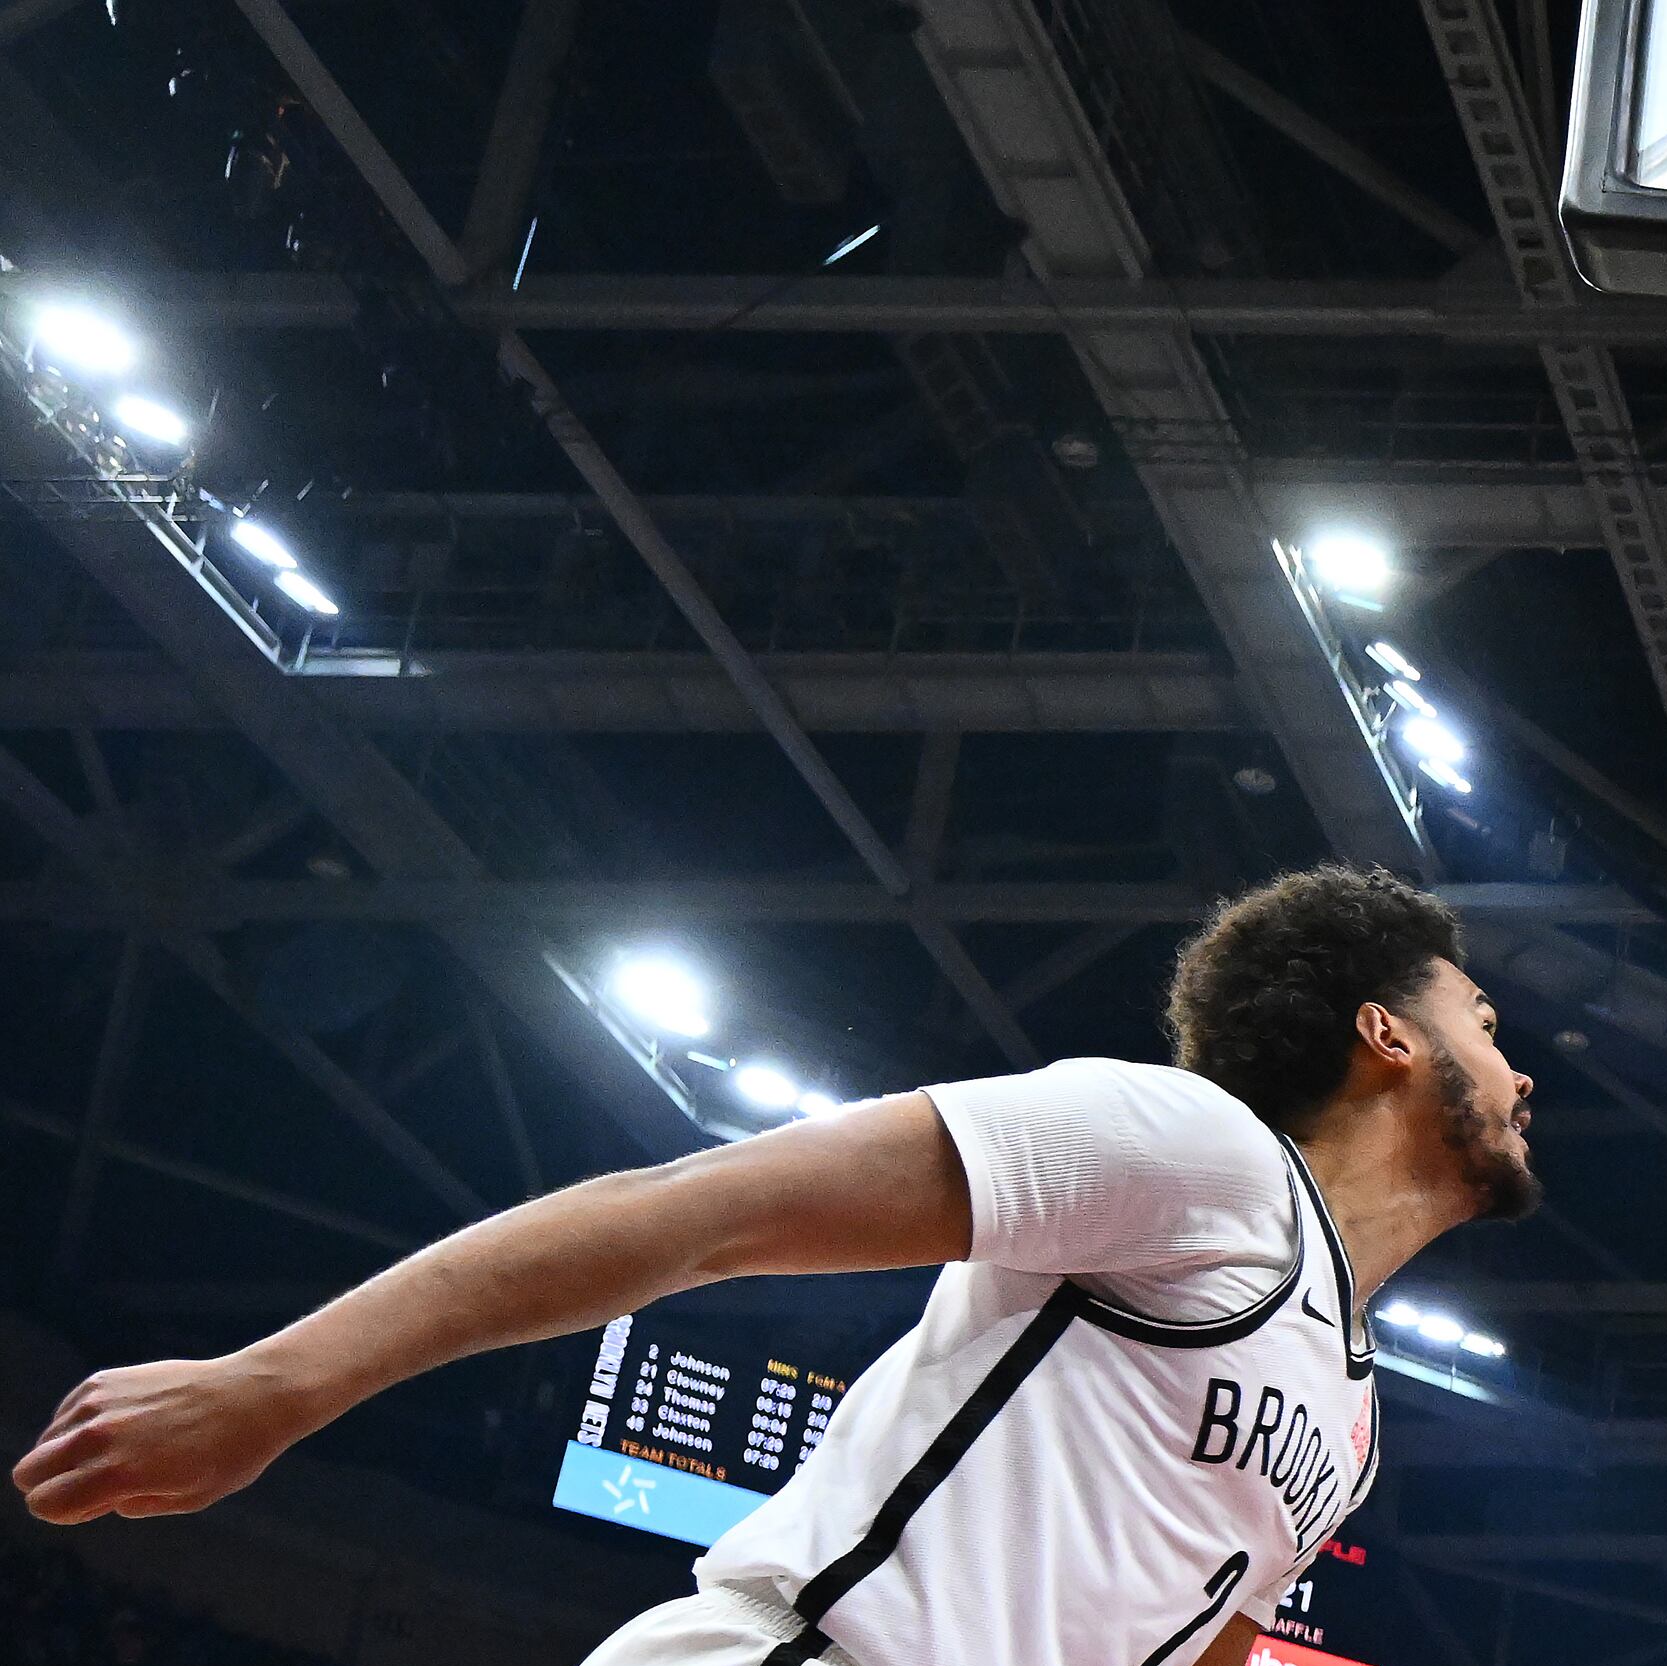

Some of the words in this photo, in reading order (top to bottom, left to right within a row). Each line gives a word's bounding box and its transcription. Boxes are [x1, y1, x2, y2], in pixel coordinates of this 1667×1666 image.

[640, 1361, 658, 1380] 21
[666, 1369, 726, 1401] Clowney
[670, 1351, 731, 1382] Johnson
[631, 1396, 650, 1415] 33
[657, 1404, 711, 1433] Claxton
[664, 1386, 716, 1415] Thomas
[652, 1422, 713, 1452] Johnson
[620, 1438, 665, 1464] TEAM
[669, 1451, 728, 1481] TOTALS
[1191, 1377, 1341, 1565] BROOKLY
